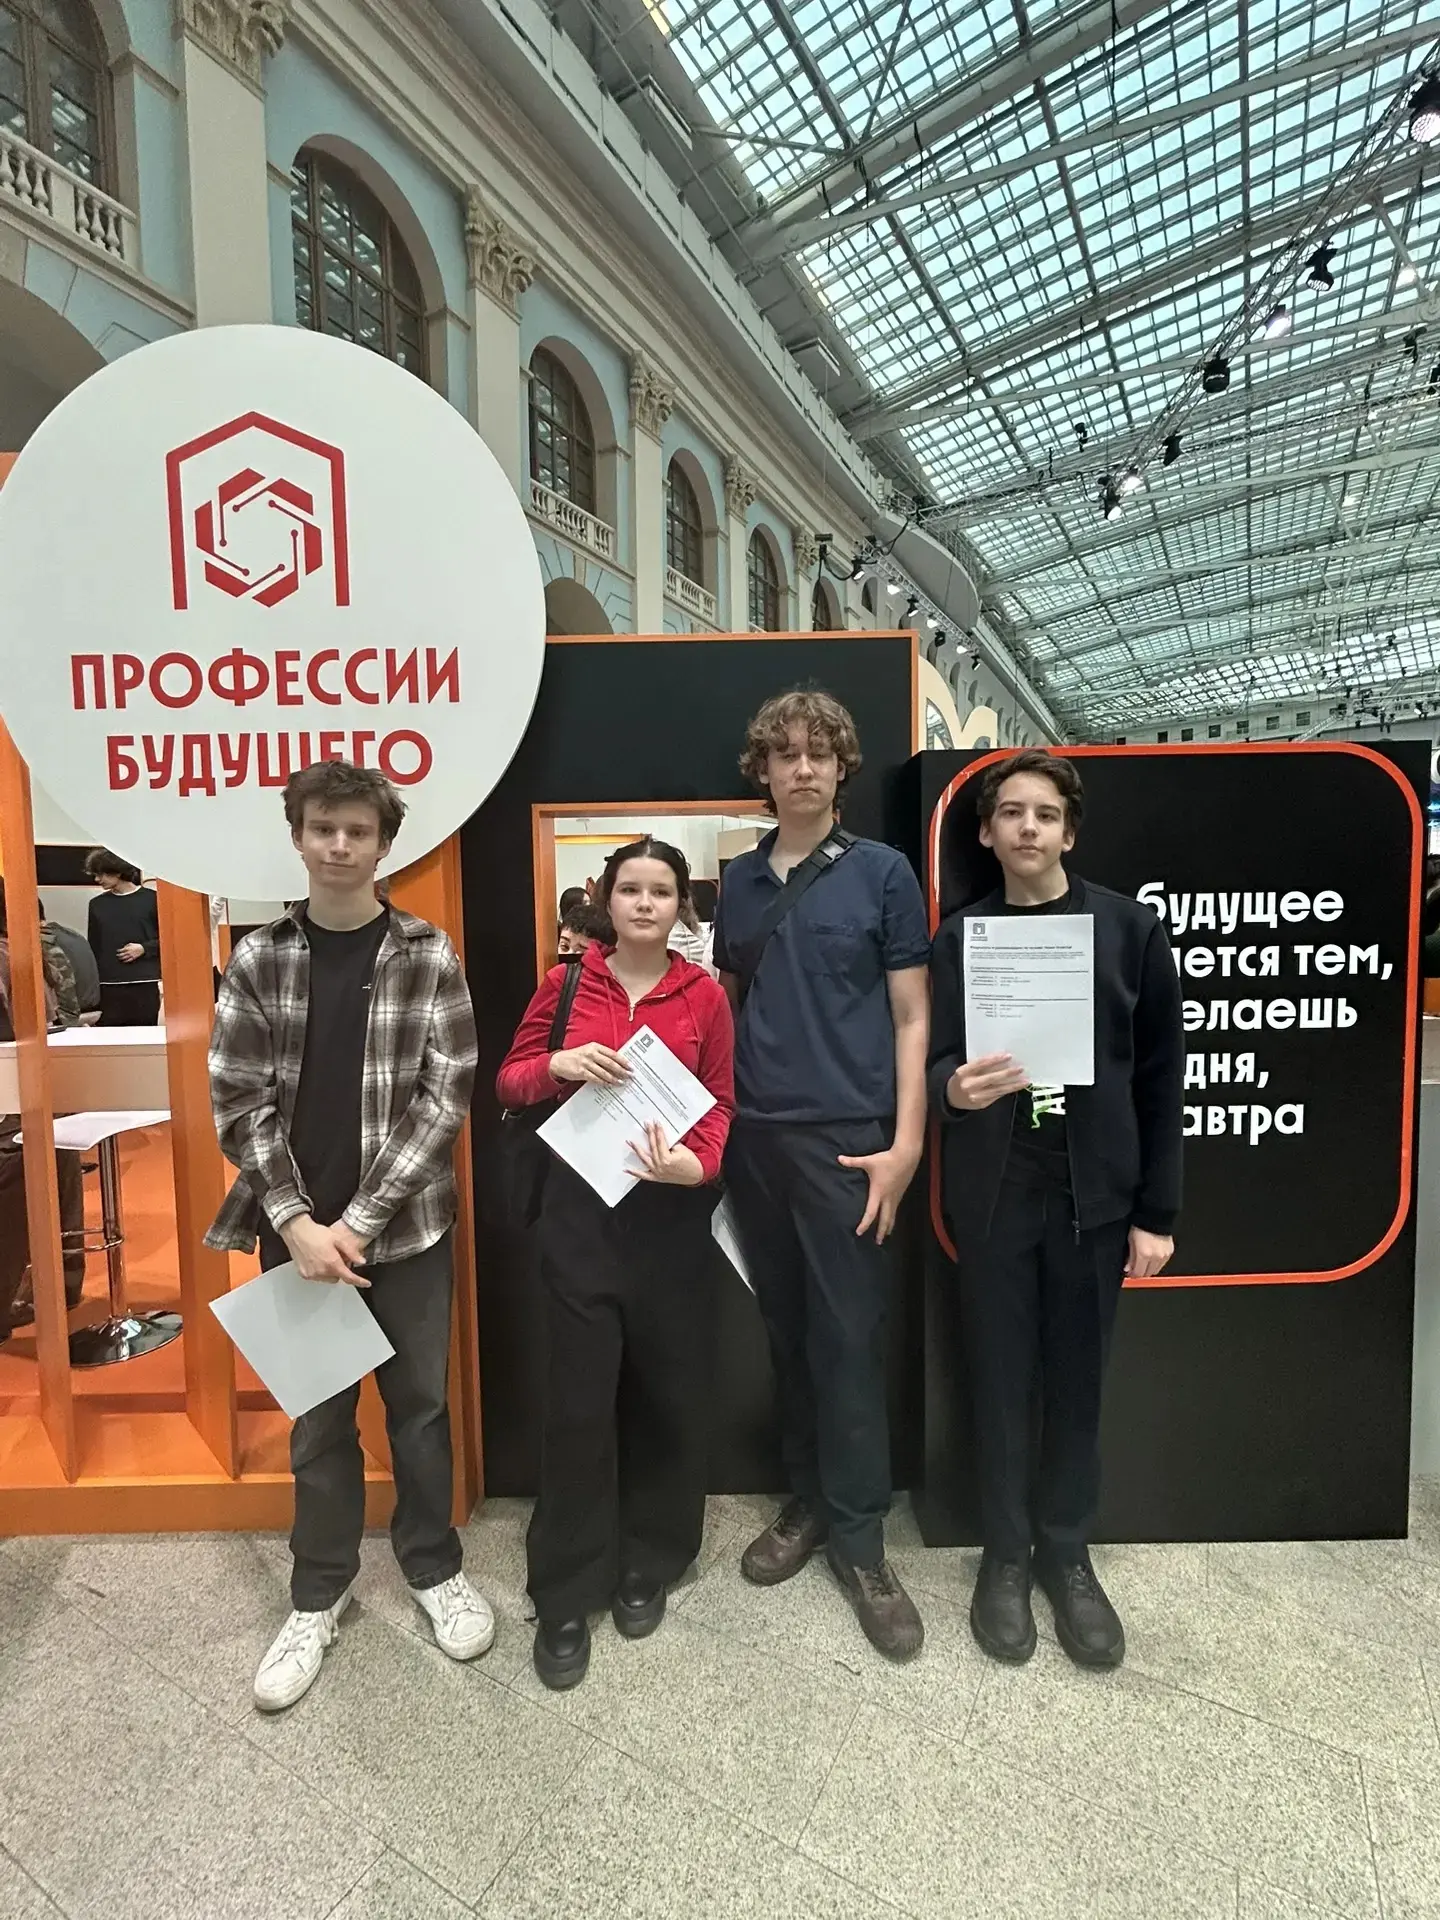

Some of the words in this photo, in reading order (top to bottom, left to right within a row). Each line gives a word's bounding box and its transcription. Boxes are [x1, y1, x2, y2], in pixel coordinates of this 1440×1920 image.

[71, 647, 460, 709] ПРОФЕССИИ
[1135, 881, 1345, 936] будущее
[1171, 945, 1281, 979] ется
[1293, 943, 1394, 981] тем,
[1181, 997, 1359, 1032] елаешь
[1183, 1052, 1270, 1090] дня,
[1182, 1102, 1305, 1147] автра
